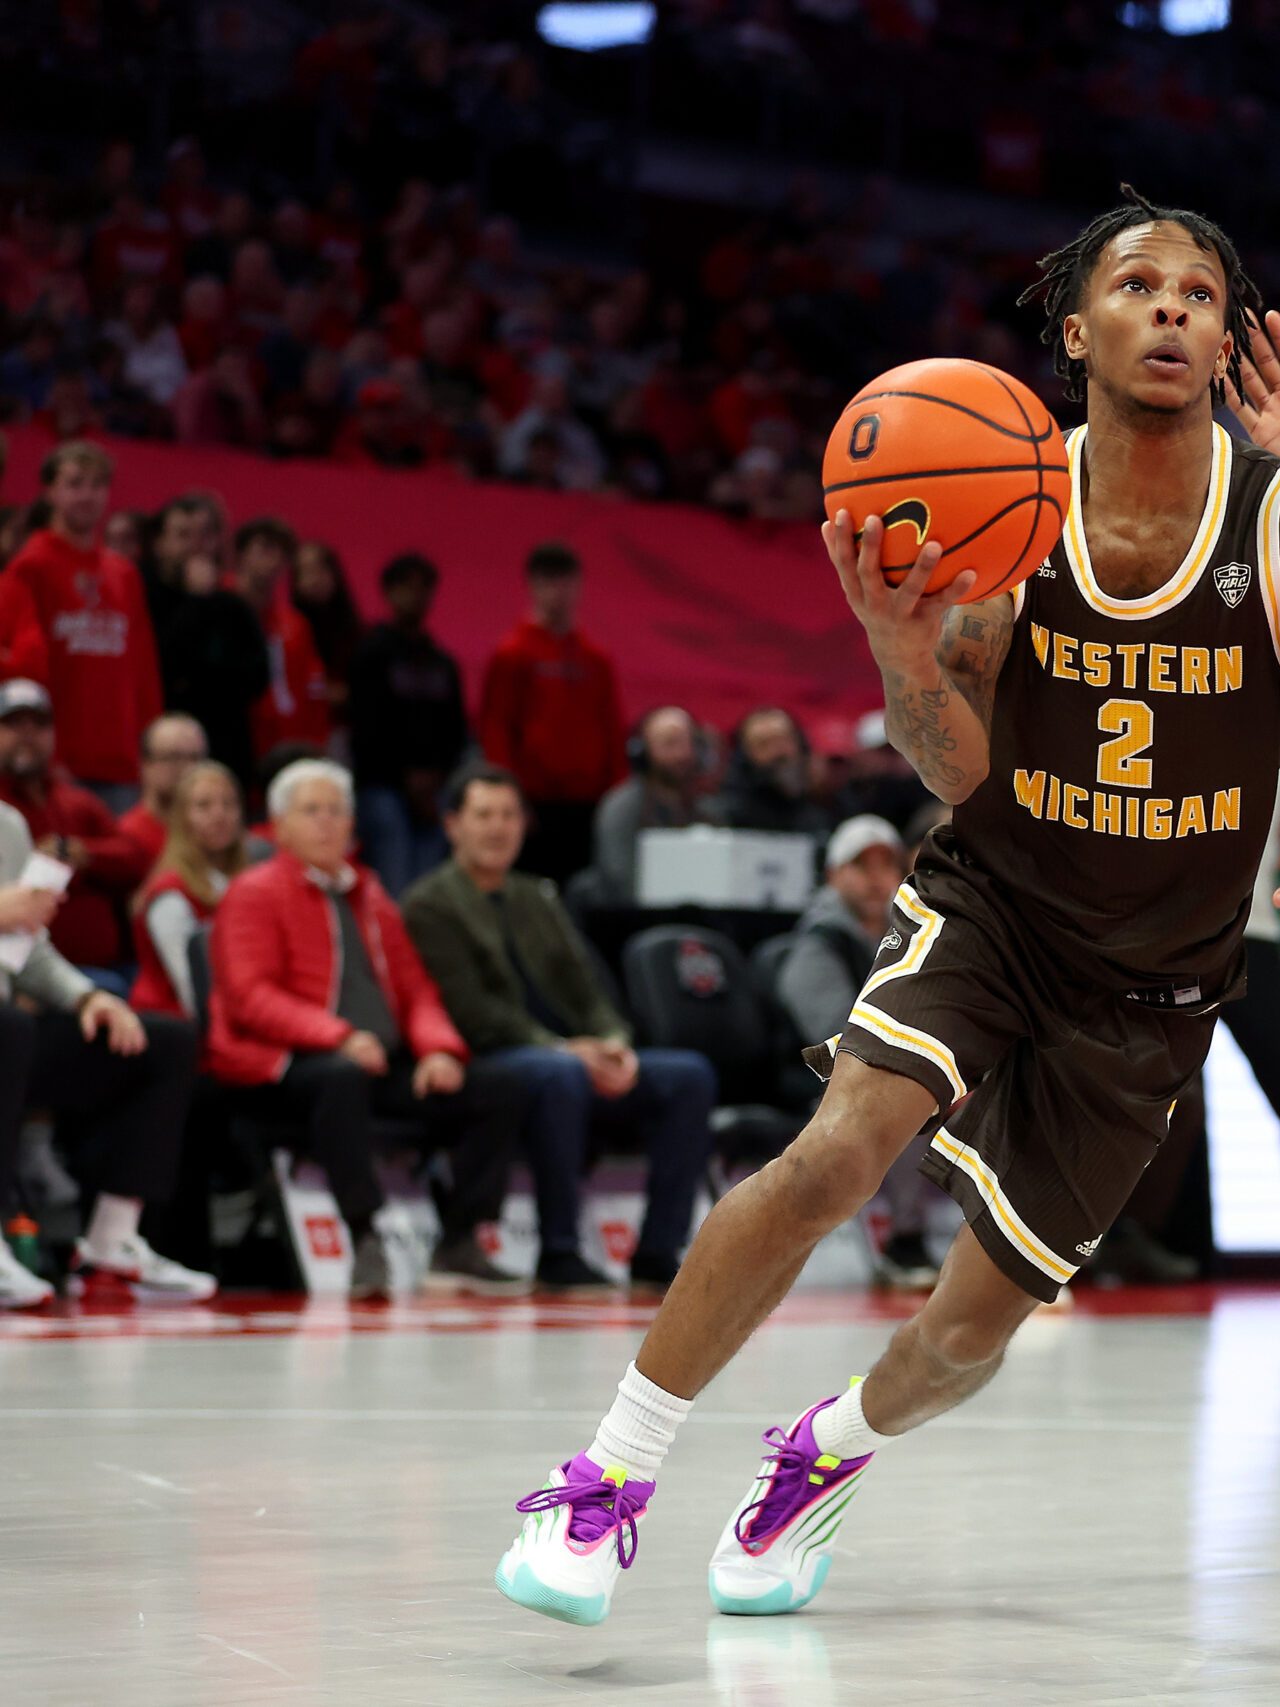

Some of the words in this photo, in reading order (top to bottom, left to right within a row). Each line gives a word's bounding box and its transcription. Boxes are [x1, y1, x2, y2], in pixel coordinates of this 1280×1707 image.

[1037, 564, 1057, 579] das
[1030, 621, 1243, 694] WESTERN
[1097, 698, 1154, 789] 2
[1013, 768, 1241, 840] MICHIGAN
